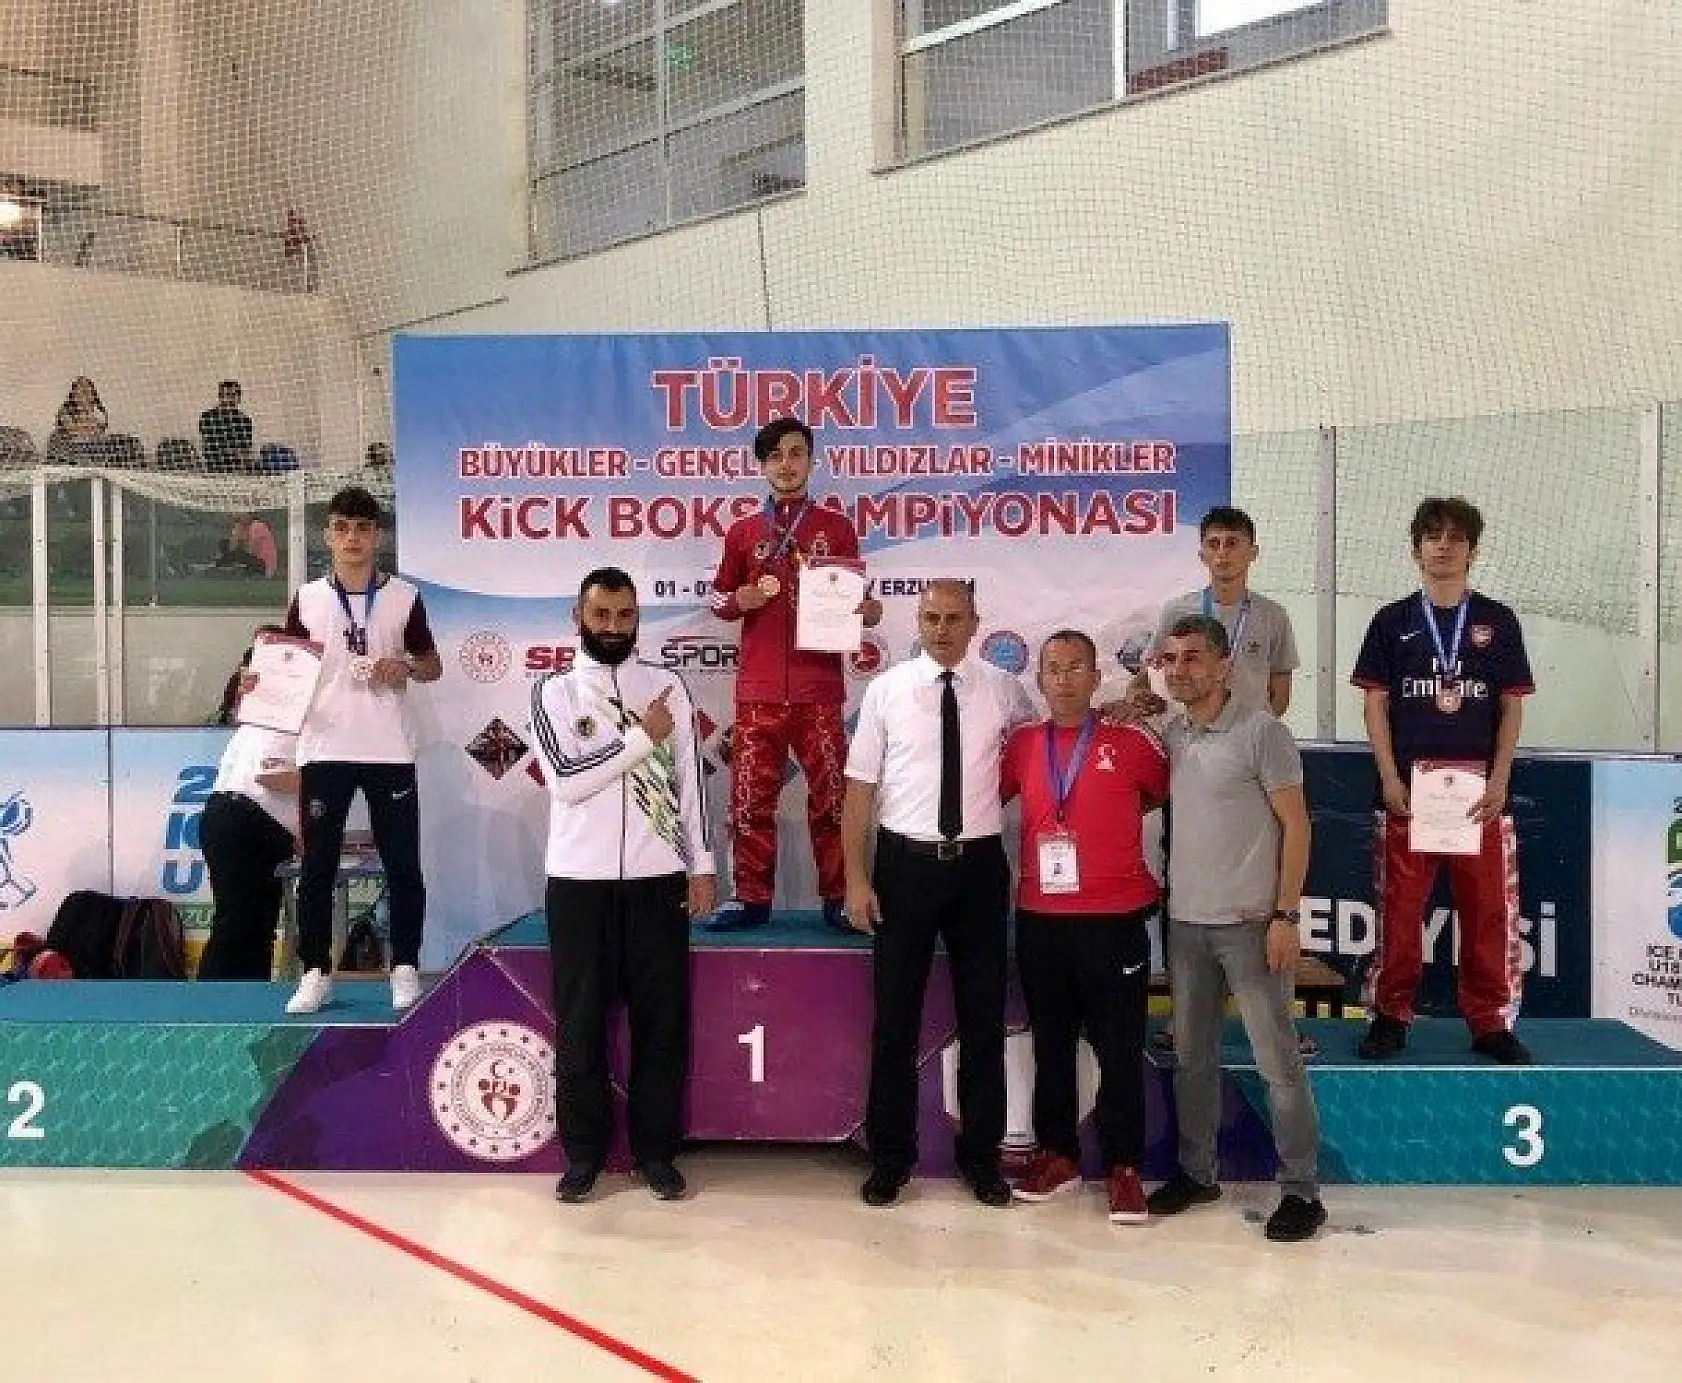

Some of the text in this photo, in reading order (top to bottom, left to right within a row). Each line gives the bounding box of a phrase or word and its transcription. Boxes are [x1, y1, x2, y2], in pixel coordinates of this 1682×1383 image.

[653, 354, 977, 432] TÜRKİYE
[459, 442, 631, 480] BÜYÜKLER
[655, 447, 768, 482] GENÇL
[827, 443, 994, 478] YILDIZLAR
[1017, 437, 1177, 475] MİNİKLER
[655, 580, 676, 596] 01
[694, 580, 712, 596] 0
[881, 578, 976, 597] ERZU
[1402, 674, 1489, 699] Emiate
[738, 1025, 765, 1083] 1
[7, 1082, 45, 1138] 2
[1502, 1105, 1545, 1166] 3
